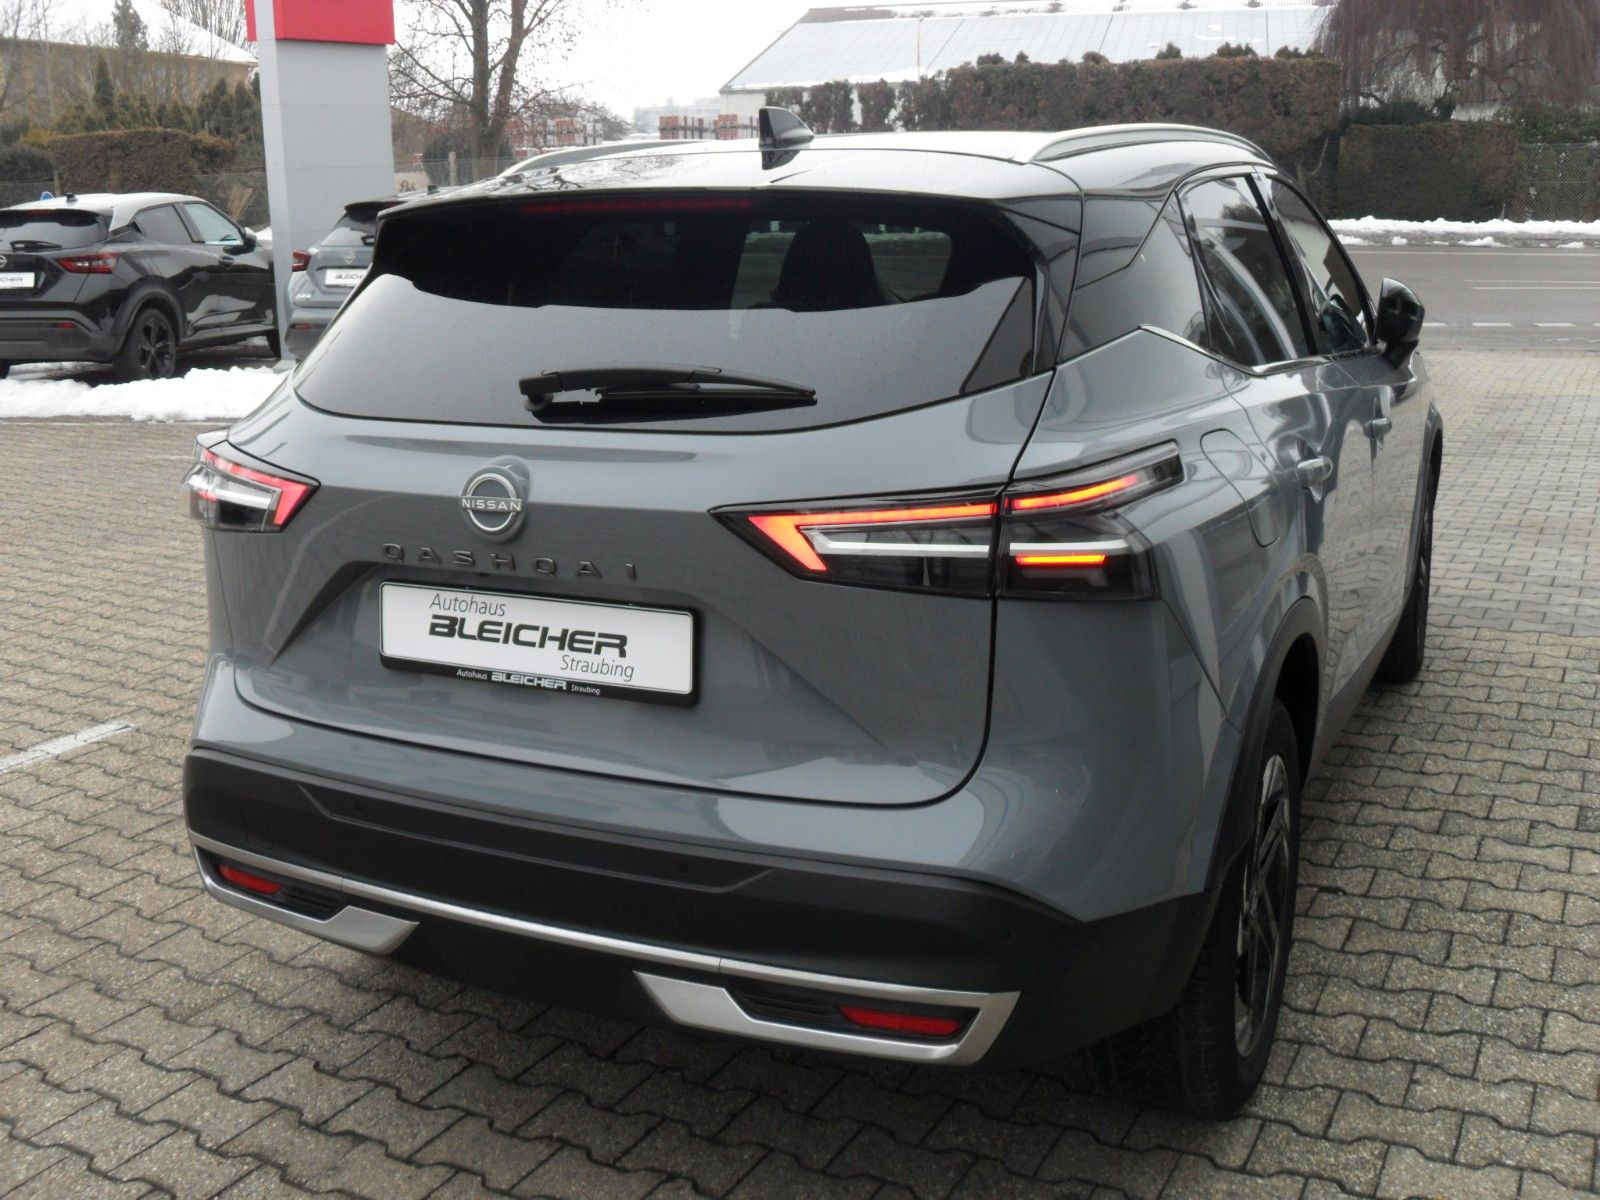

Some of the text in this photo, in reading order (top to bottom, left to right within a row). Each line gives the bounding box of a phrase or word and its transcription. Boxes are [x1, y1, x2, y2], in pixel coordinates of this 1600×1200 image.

[462, 499, 522, 511] NISSAN
[384, 543, 637, 579] QASHQAI
[429, 593, 506, 616] Autohaus
[428, 614, 628, 657] BLEICHER
[456, 668, 601, 695] Autohaus BLEICHER Straubing
[560, 655, 635, 682] Straubing
